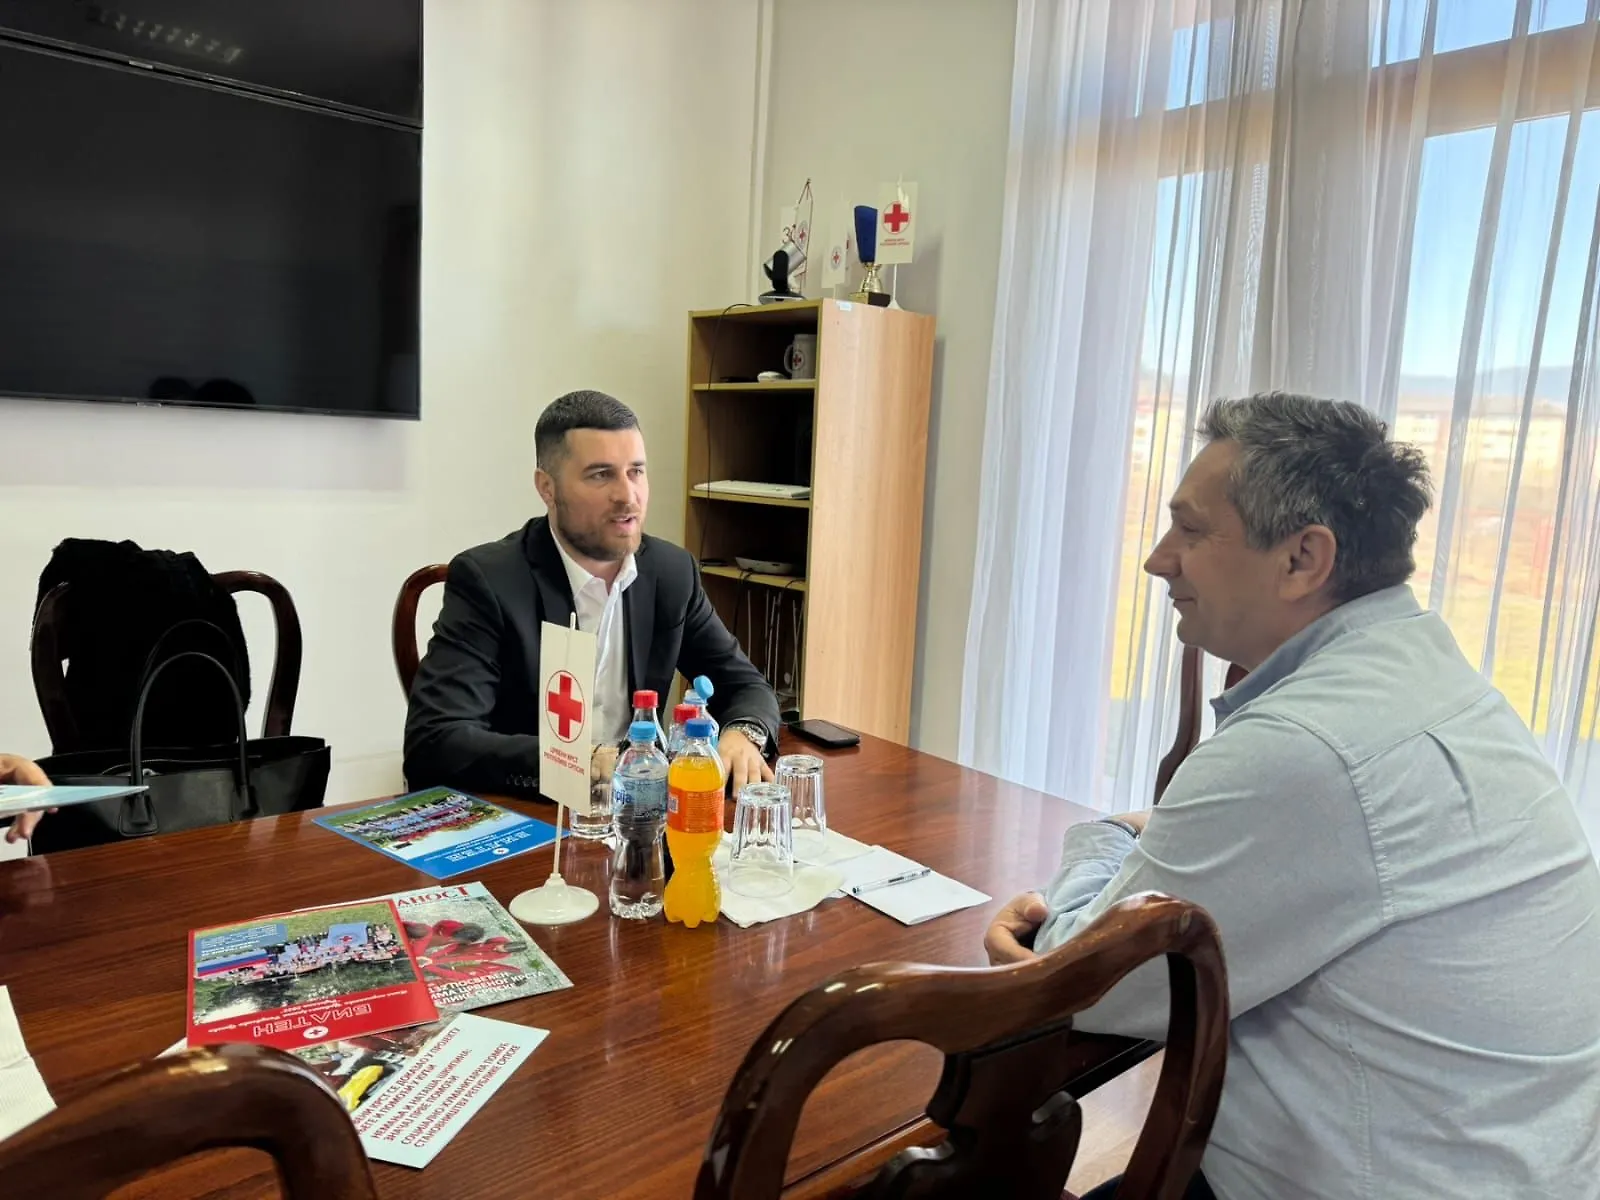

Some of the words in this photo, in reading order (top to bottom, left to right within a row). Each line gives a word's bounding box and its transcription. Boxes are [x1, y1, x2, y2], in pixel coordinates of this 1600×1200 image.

[397, 885, 469, 906] АНОСТ
[253, 1003, 372, 1038] БИЛТЕН
[370, 1093, 390, 1108] КРСТ
